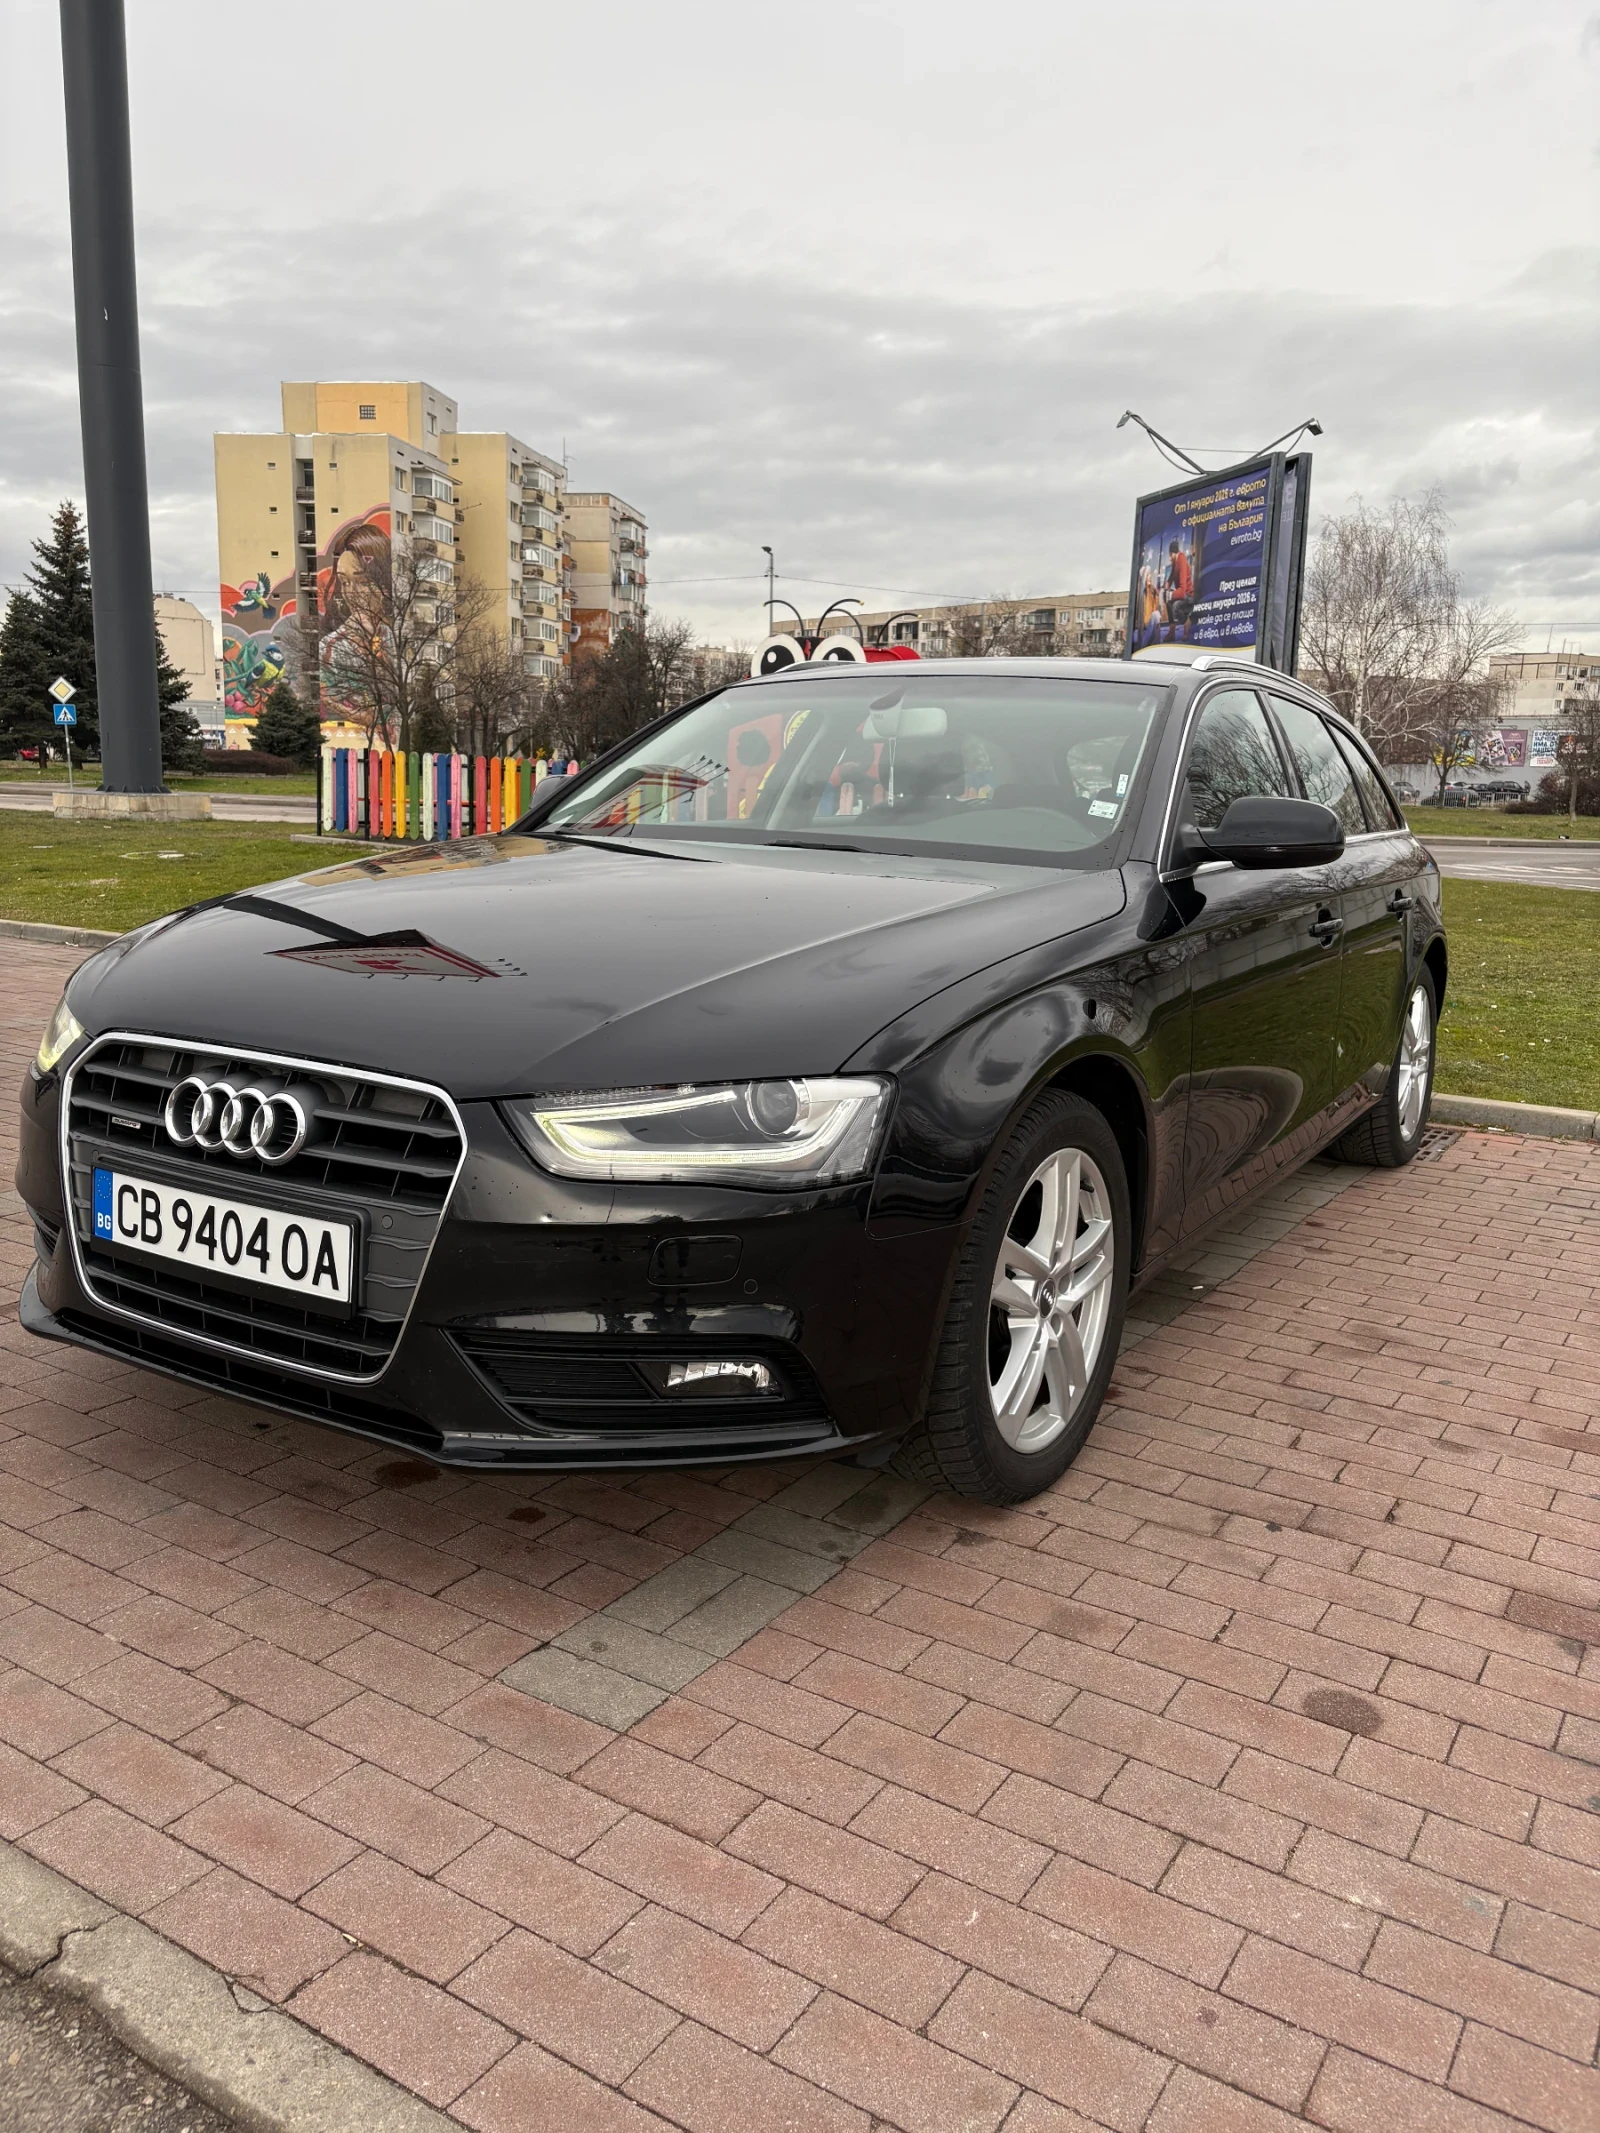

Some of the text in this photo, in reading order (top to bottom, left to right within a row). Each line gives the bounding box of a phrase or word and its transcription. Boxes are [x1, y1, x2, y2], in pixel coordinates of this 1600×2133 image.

[1174, 503, 1187, 515] От
[1190, 494, 1215, 510] януари
[1236, 478, 1267, 496] еврото
[1187, 506, 1236, 527] официалната
[1236, 495, 1265, 511] валута
[1218, 522, 1228, 533] на
[1228, 512, 1264, 531] България
[1230, 529, 1263, 546] evroto.bg
[1219, 576, 1257, 593] През целия
[1193, 591, 1257, 612] месец януари 2026 г.
[1197, 609, 1255, 625] може да се плаща
[1225, 624, 1231, 635] в
[1230, 621, 1254, 635] левове.
[97, 1211, 112, 1231] BG
[117, 1184, 341, 1291] CB 9404 OA
